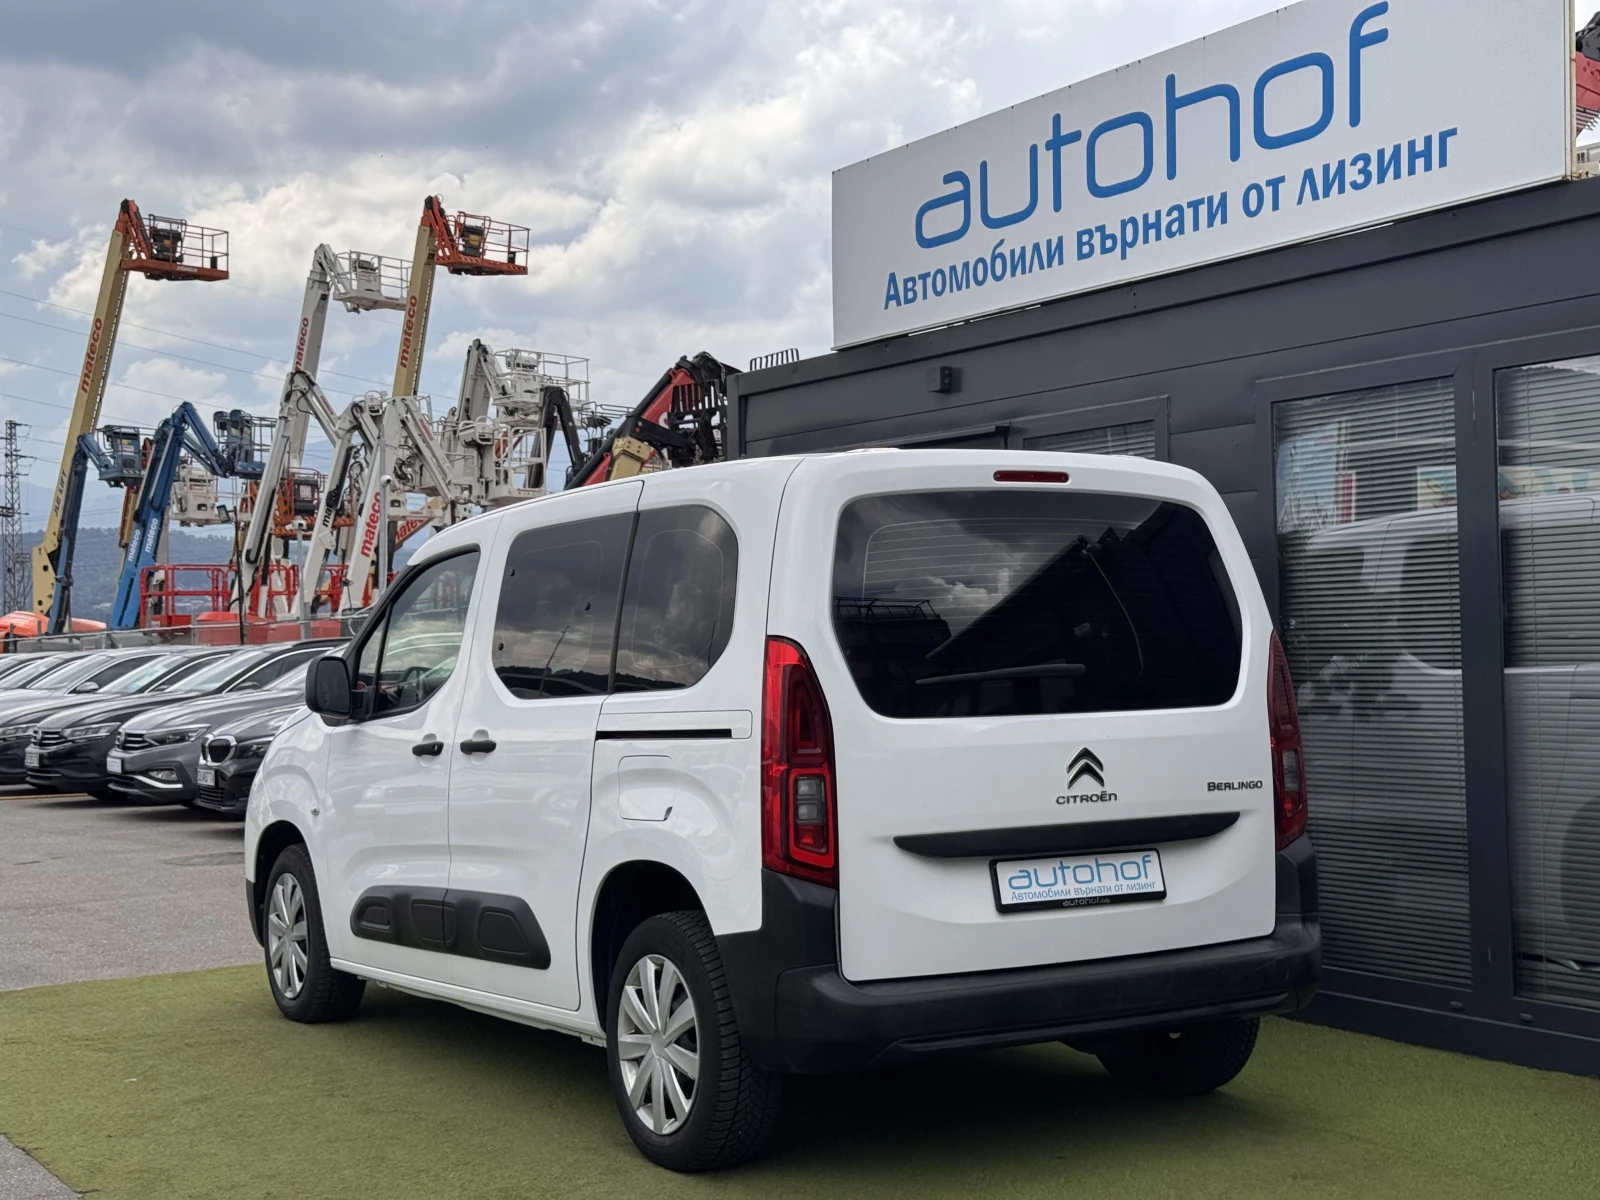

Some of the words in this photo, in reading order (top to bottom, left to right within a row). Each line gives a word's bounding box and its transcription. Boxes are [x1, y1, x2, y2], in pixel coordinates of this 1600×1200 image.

[915, 1, 1389, 249] autohof
[883, 237, 1064, 310] Автомобили
[1076, 190, 1228, 260] върнати
[1242, 175, 1286, 218] от
[1297, 127, 1458, 206] лизинг
[81, 317, 103, 394] mateco
[400, 295, 417, 369] mateco
[128, 529, 141, 562] mateco
[144, 517, 159, 553] mateco
[1008, 854, 1152, 890] autohof
[1011, 887, 1071, 902] Автомобили
[1073, 884, 1112, 896] върнати
[1114, 884, 1124, 893] от
[1126, 881, 1157, 892] лизинг
